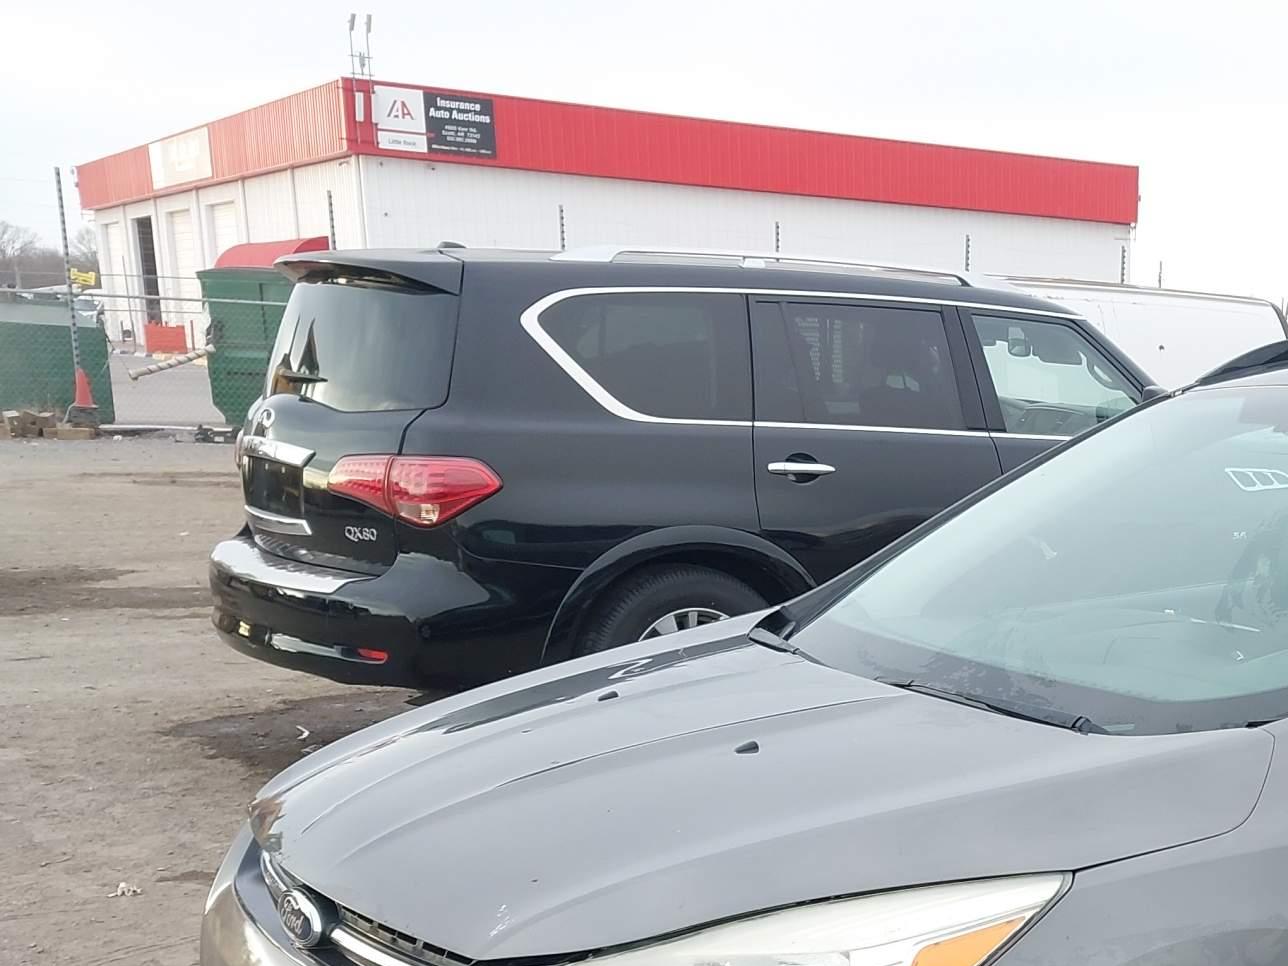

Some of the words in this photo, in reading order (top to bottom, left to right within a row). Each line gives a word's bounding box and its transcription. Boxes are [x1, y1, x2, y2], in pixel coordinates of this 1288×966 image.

[437, 97, 481, 111] Insurance
[429, 107, 450, 119] Auto
[451, 109, 491, 123] Auctions
[344, 525, 377, 542] QX80
[280, 896, 304, 935] Ford
